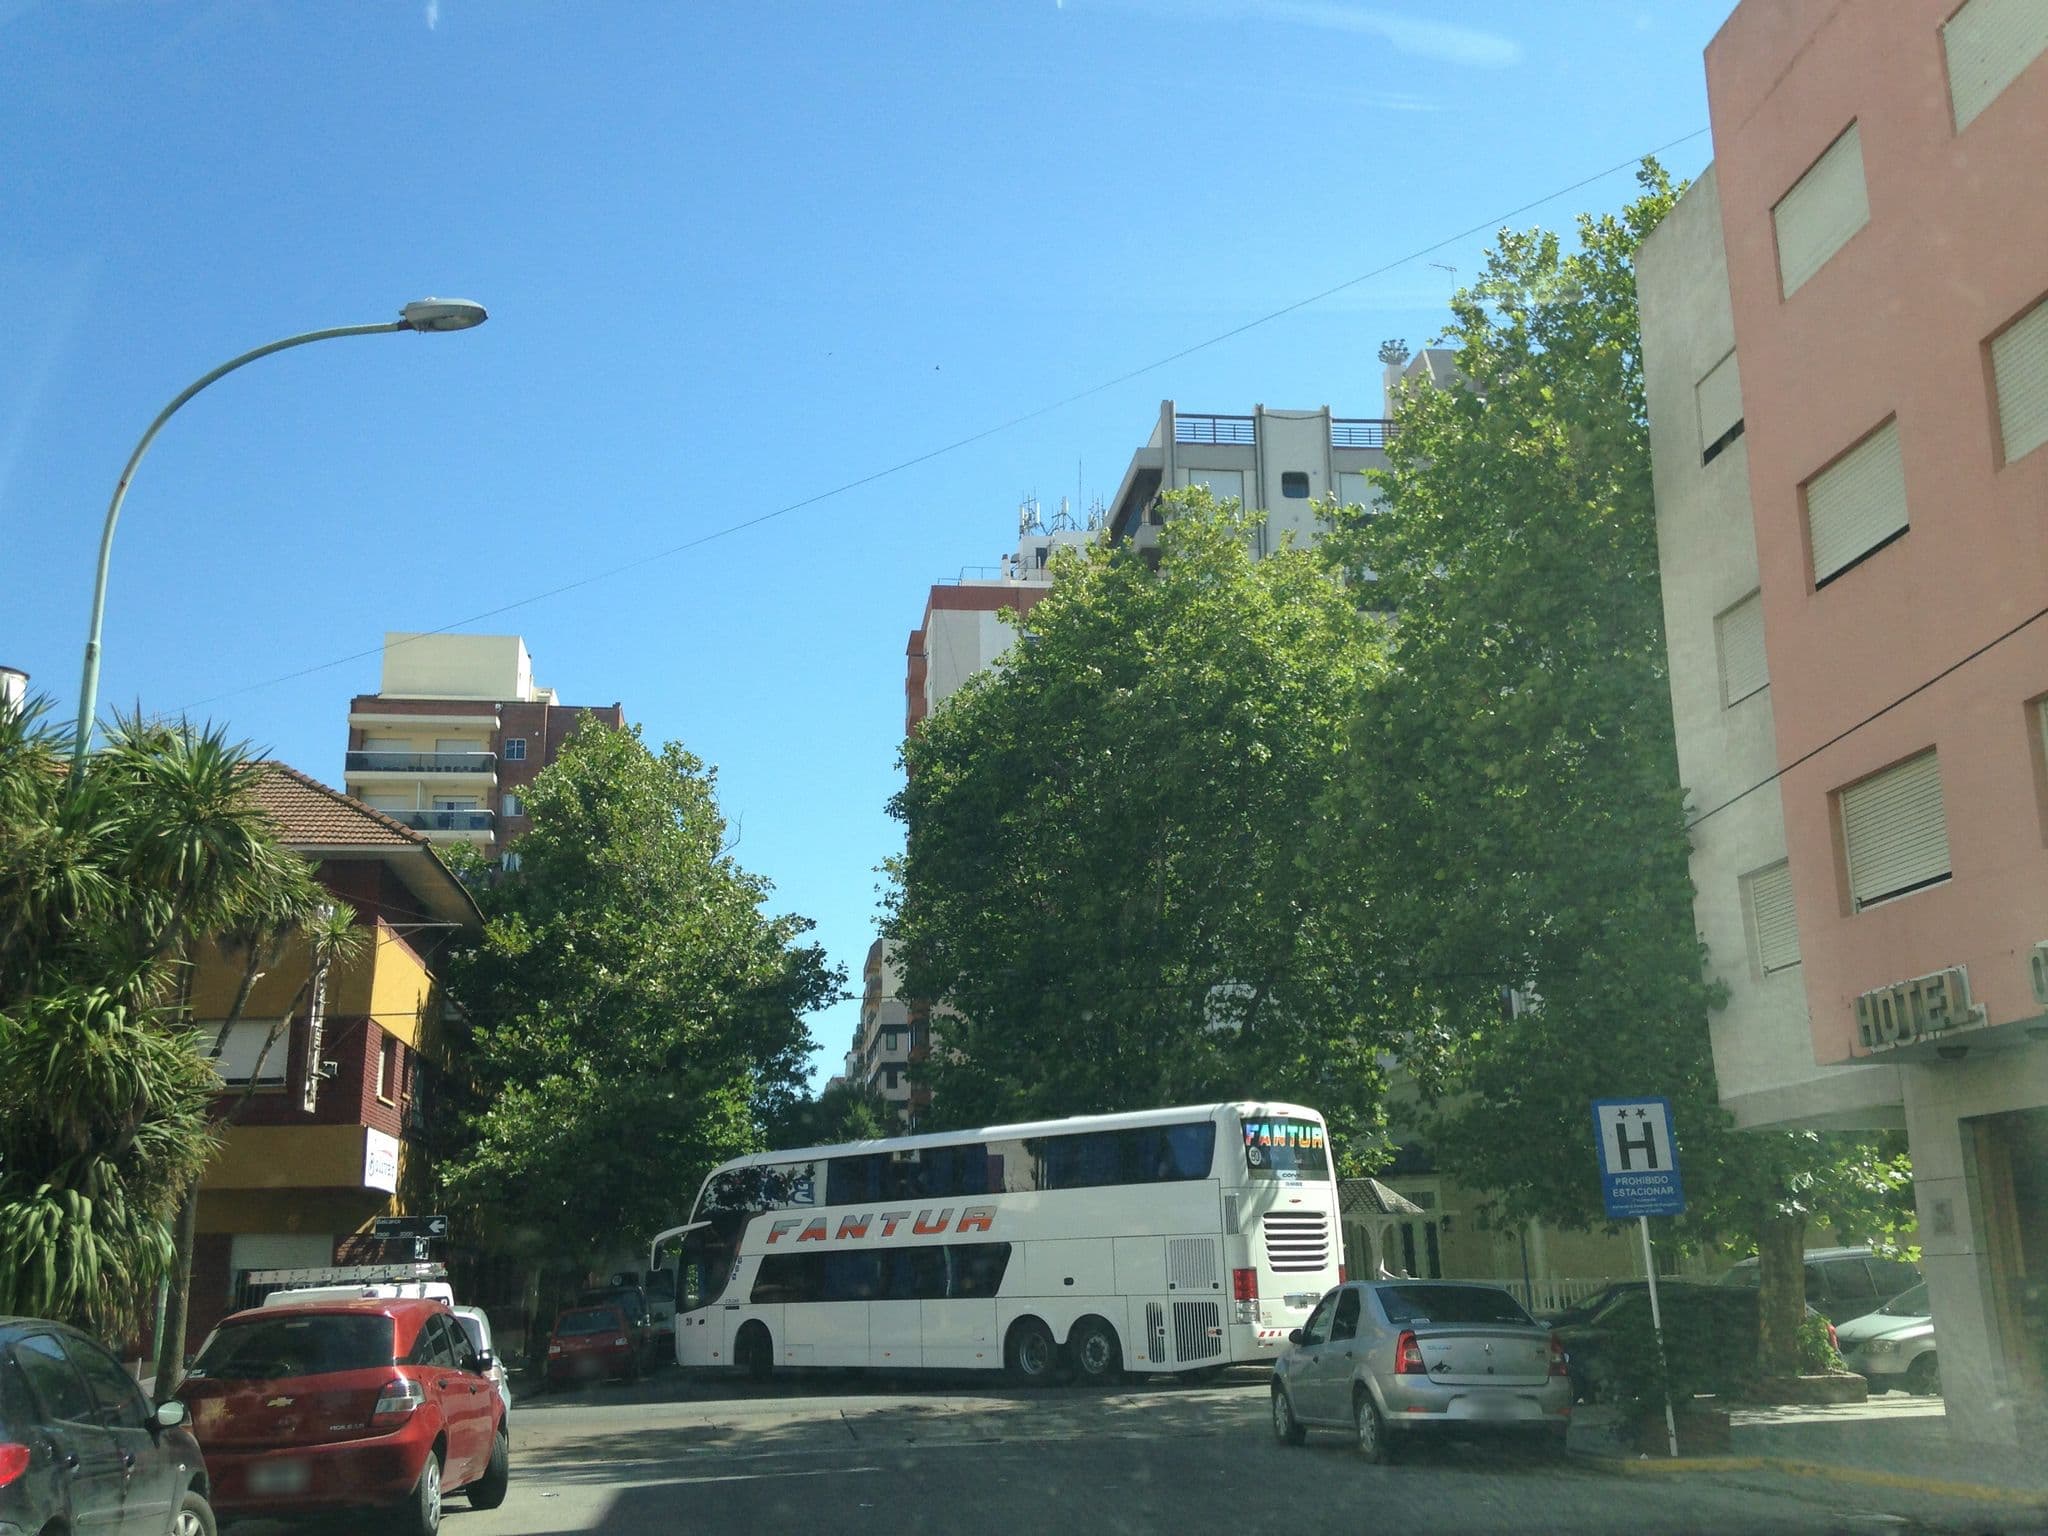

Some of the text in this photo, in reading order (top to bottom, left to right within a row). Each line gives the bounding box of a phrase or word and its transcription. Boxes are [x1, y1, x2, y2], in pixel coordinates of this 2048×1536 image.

[1856, 965, 1986, 1052] HOTEL
[1246, 1124, 1323, 1148] FANTUR
[1616, 1122, 1658, 1170] H
[1612, 1186, 1674, 1197] ESTACIONAR
[1615, 1176, 1668, 1185] PROHIBIDO
[766, 1205, 998, 1244] FANTUR
